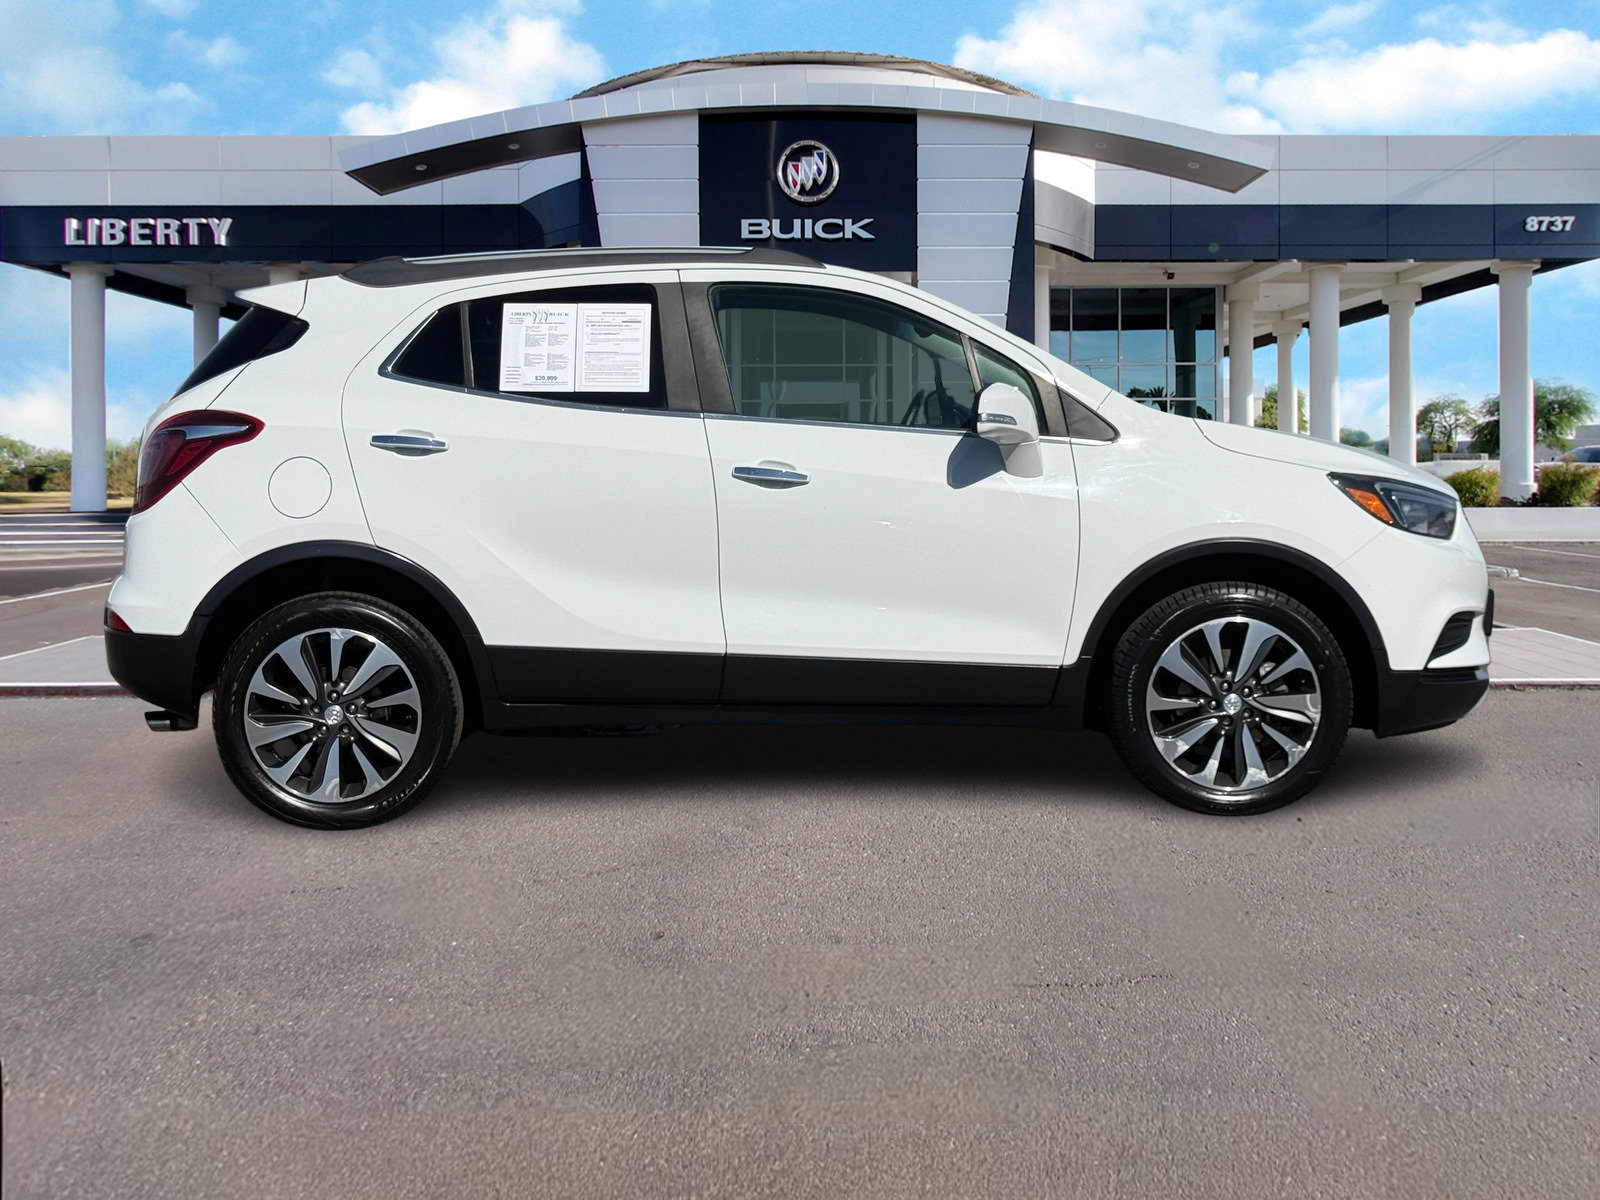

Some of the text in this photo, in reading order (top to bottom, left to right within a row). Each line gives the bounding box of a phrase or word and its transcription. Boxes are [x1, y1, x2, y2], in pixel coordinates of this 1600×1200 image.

[64, 217, 233, 246] LIBERTY
[740, 217, 876, 240] BUICK
[1524, 215, 1576, 232] 8737
